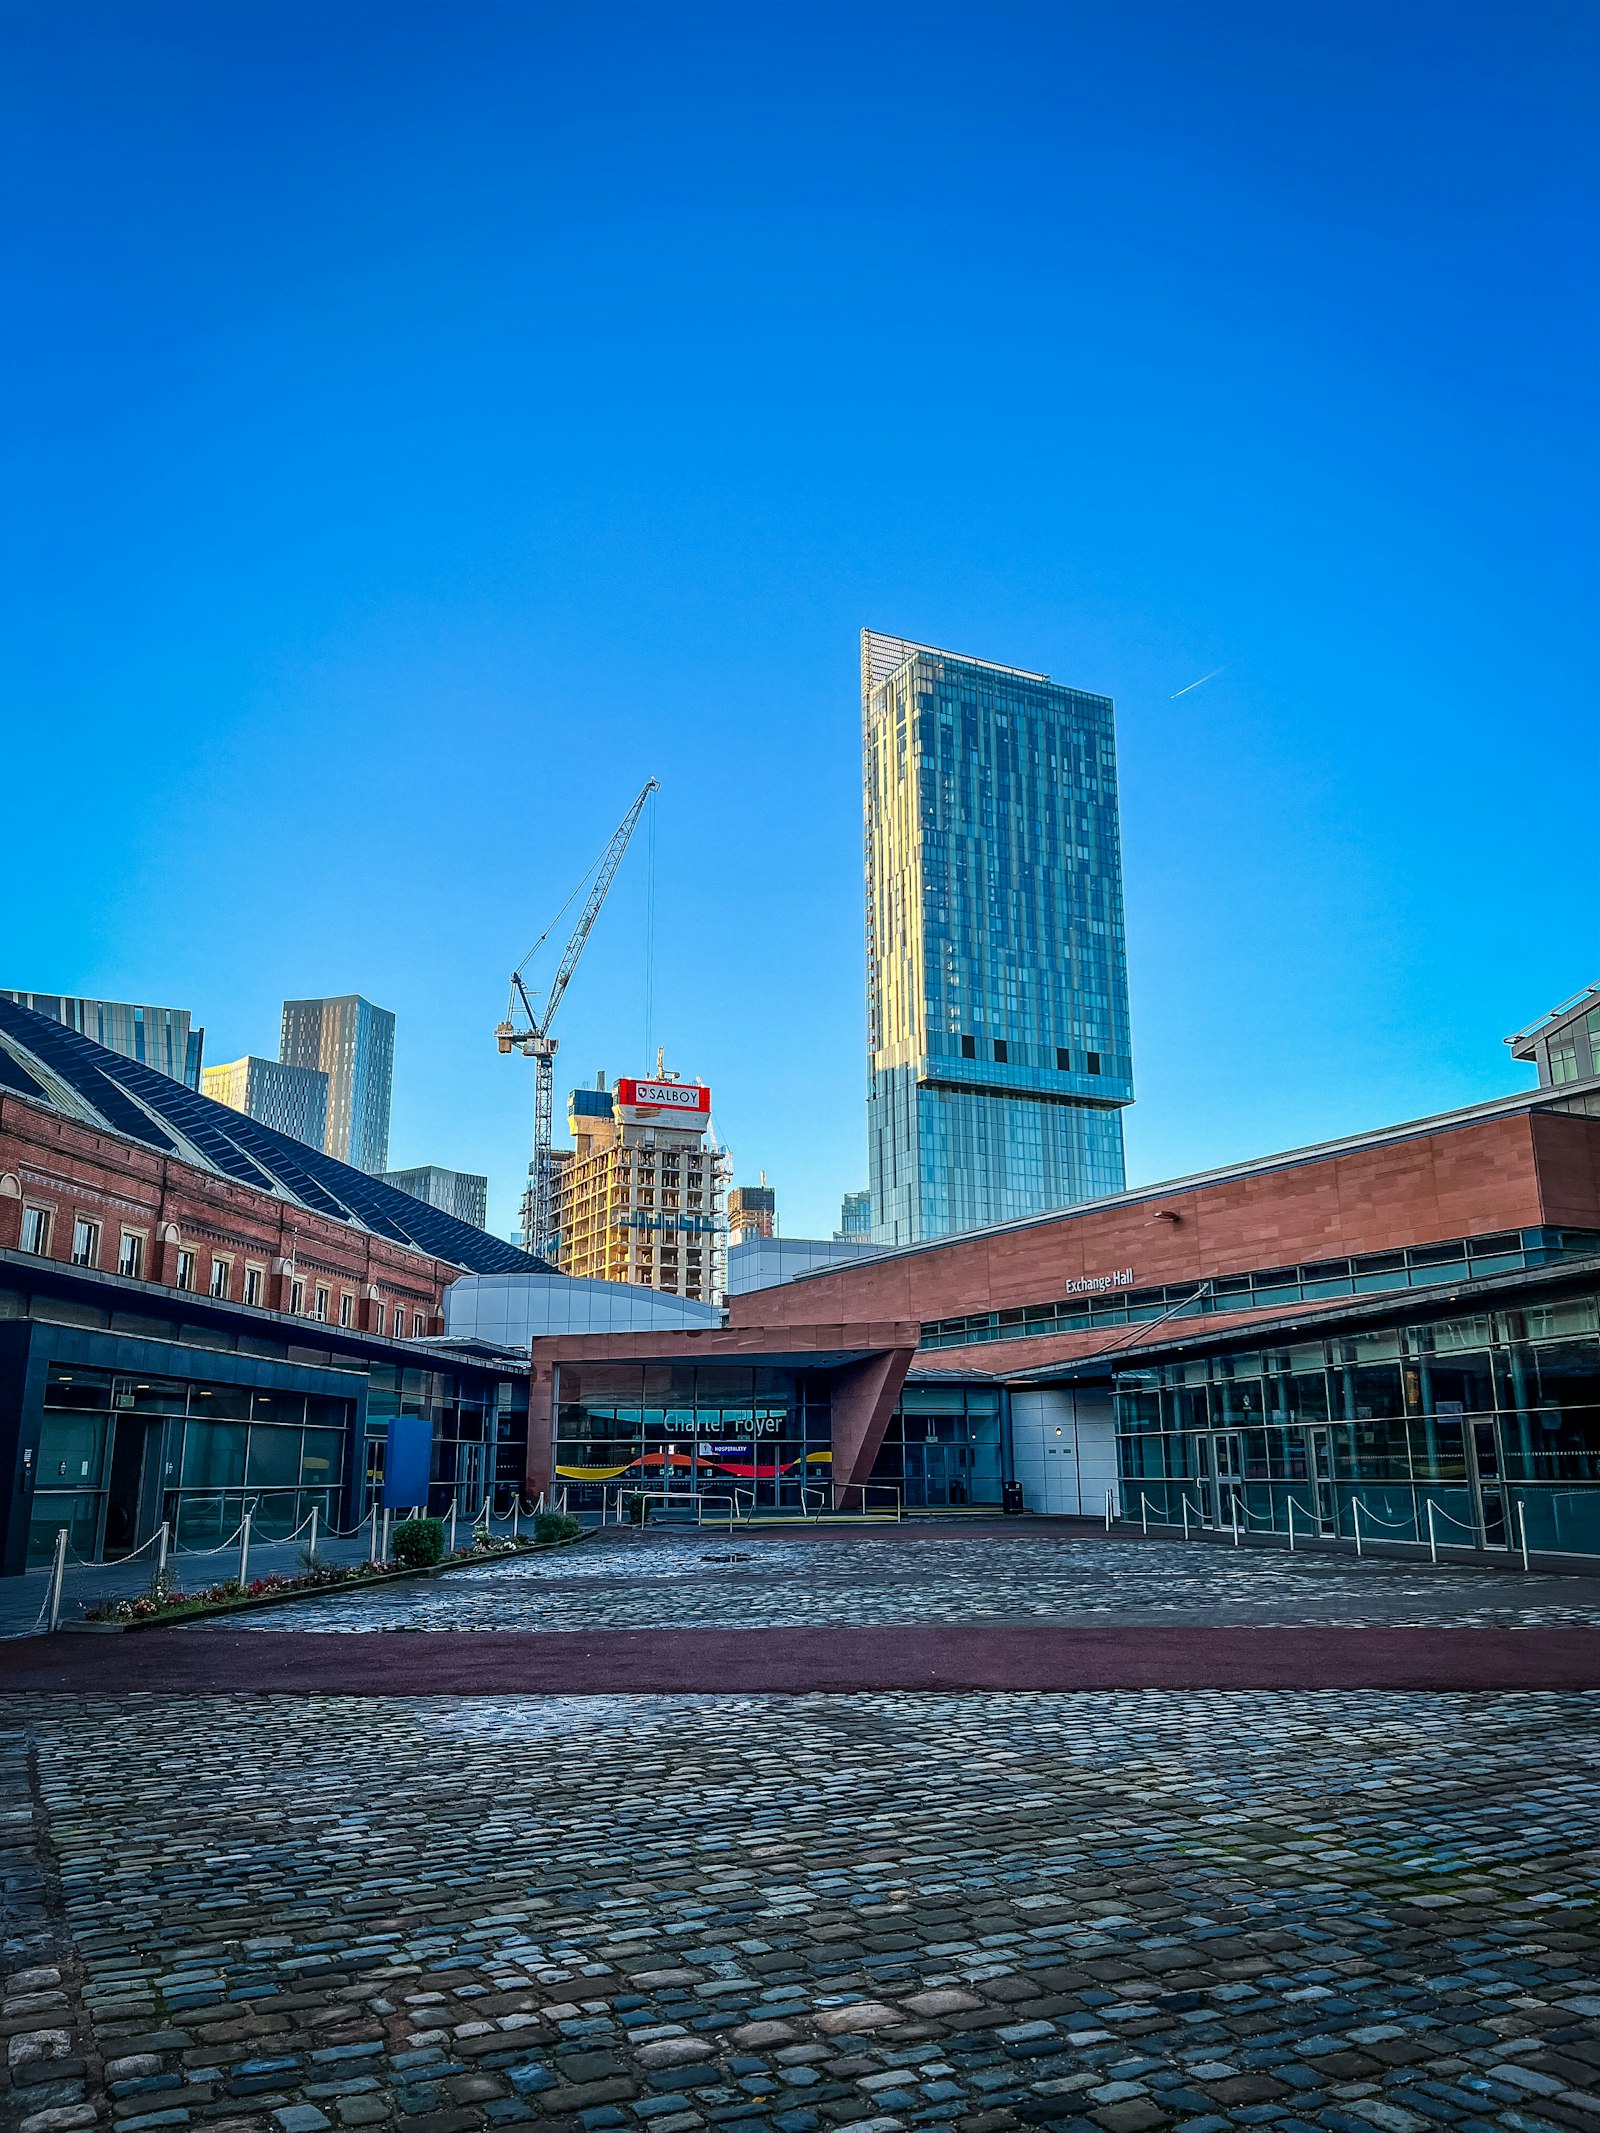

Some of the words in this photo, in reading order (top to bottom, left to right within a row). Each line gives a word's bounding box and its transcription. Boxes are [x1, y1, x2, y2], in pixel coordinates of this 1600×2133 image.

[649, 1088, 697, 1103] SALBOY
[1066, 1276, 1111, 1293] Exchange
[1113, 1268, 1133, 1285] Hall
[664, 1413, 725, 1432] Charter
[735, 1414, 783, 1437] Foyer
